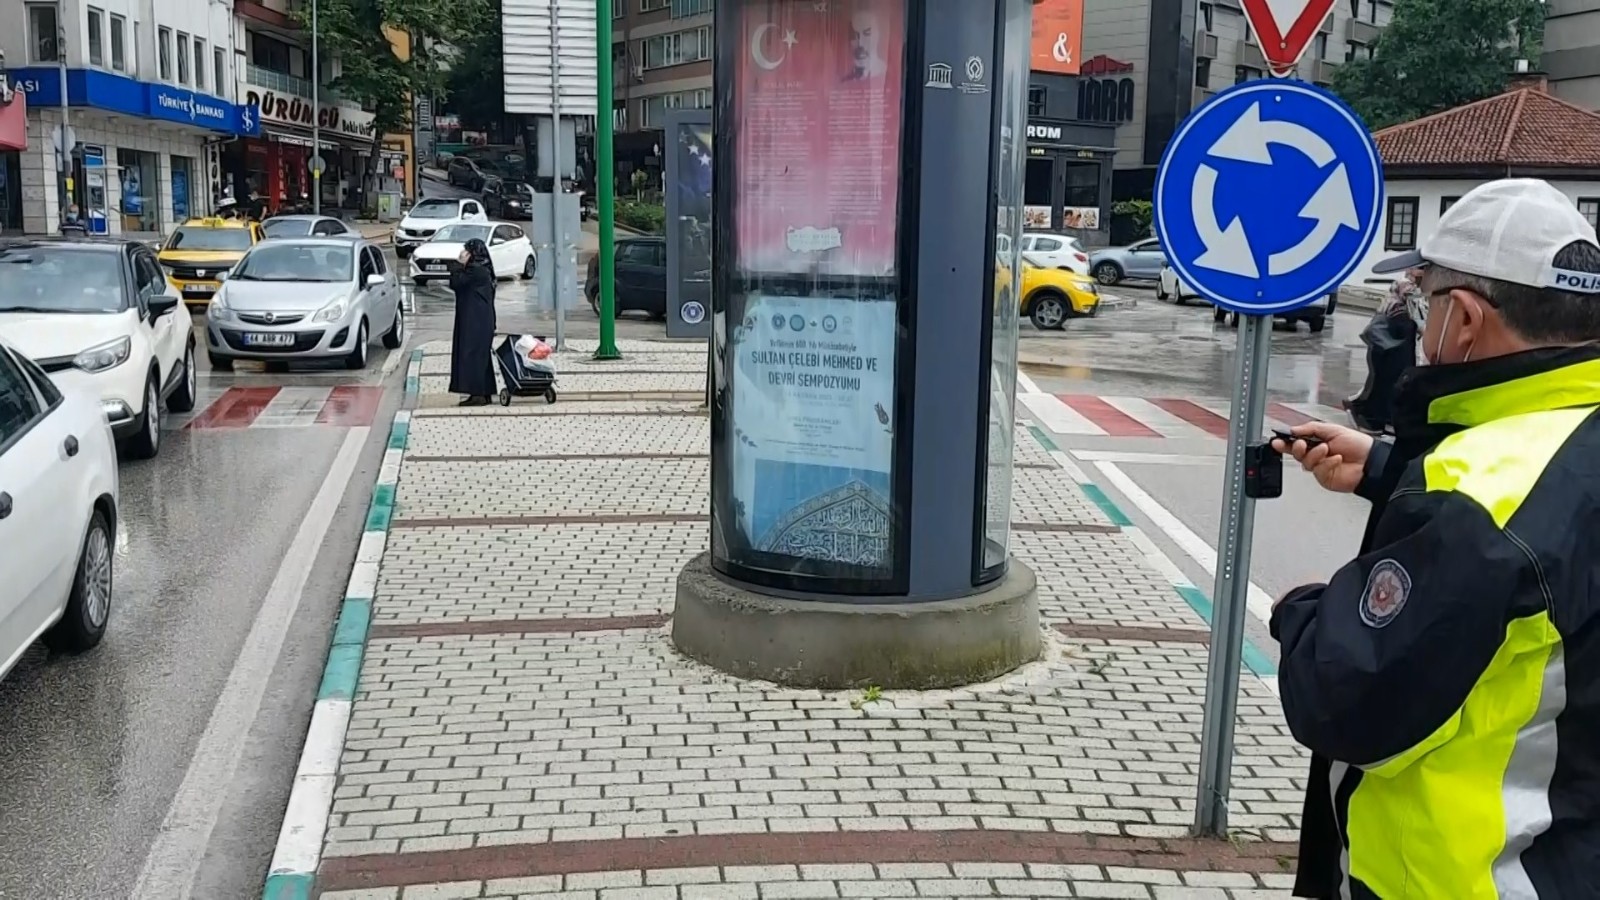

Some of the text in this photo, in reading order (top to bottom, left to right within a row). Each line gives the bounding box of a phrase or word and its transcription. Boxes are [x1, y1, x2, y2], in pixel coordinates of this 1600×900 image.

[158, 93, 189, 112] TÜRKİYE
[196, 103, 225, 119] BANKASI
[751, 351, 878, 372] SULTAN ÇELEBİ MEHMED VE
[768, 371, 861, 391] DEVRİ SEMPOZYUMU
